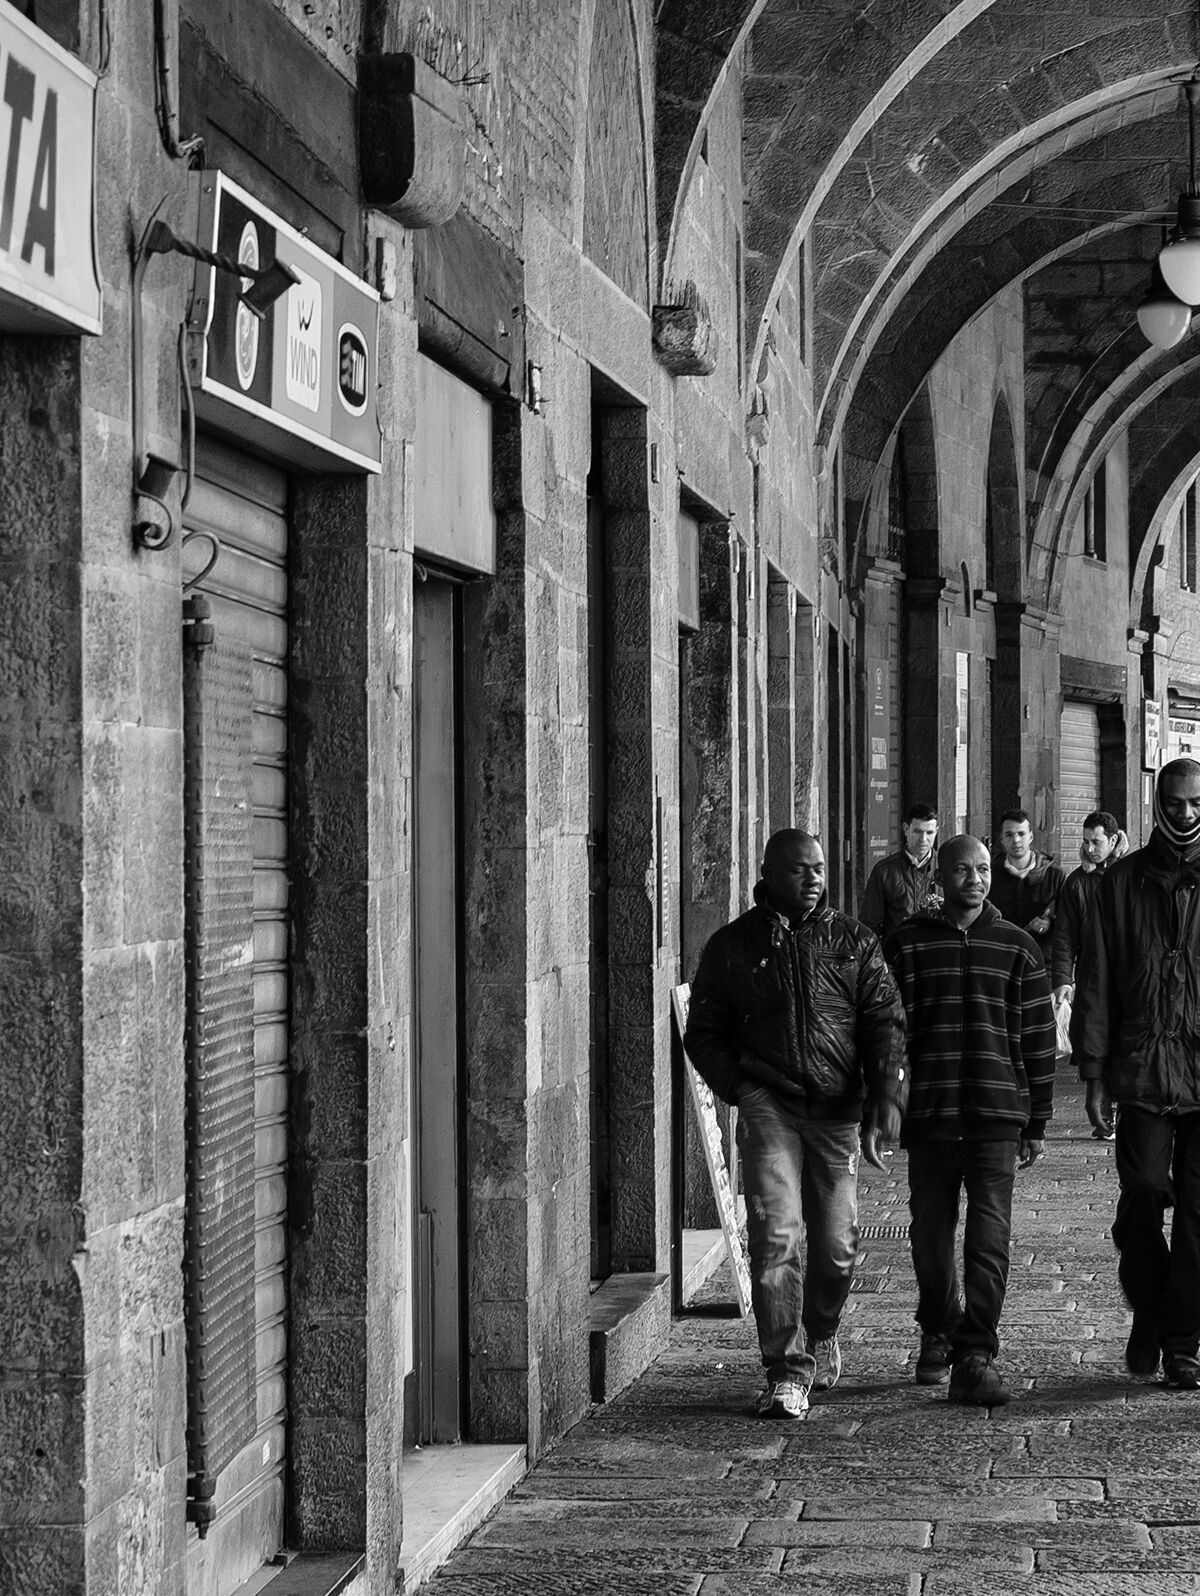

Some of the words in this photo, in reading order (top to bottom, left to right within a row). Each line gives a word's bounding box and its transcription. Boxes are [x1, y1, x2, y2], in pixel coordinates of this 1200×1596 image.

[0, 45, 57, 277] TA
[290, 335, 318, 391] WIND
[351, 348, 365, 396] TIM
